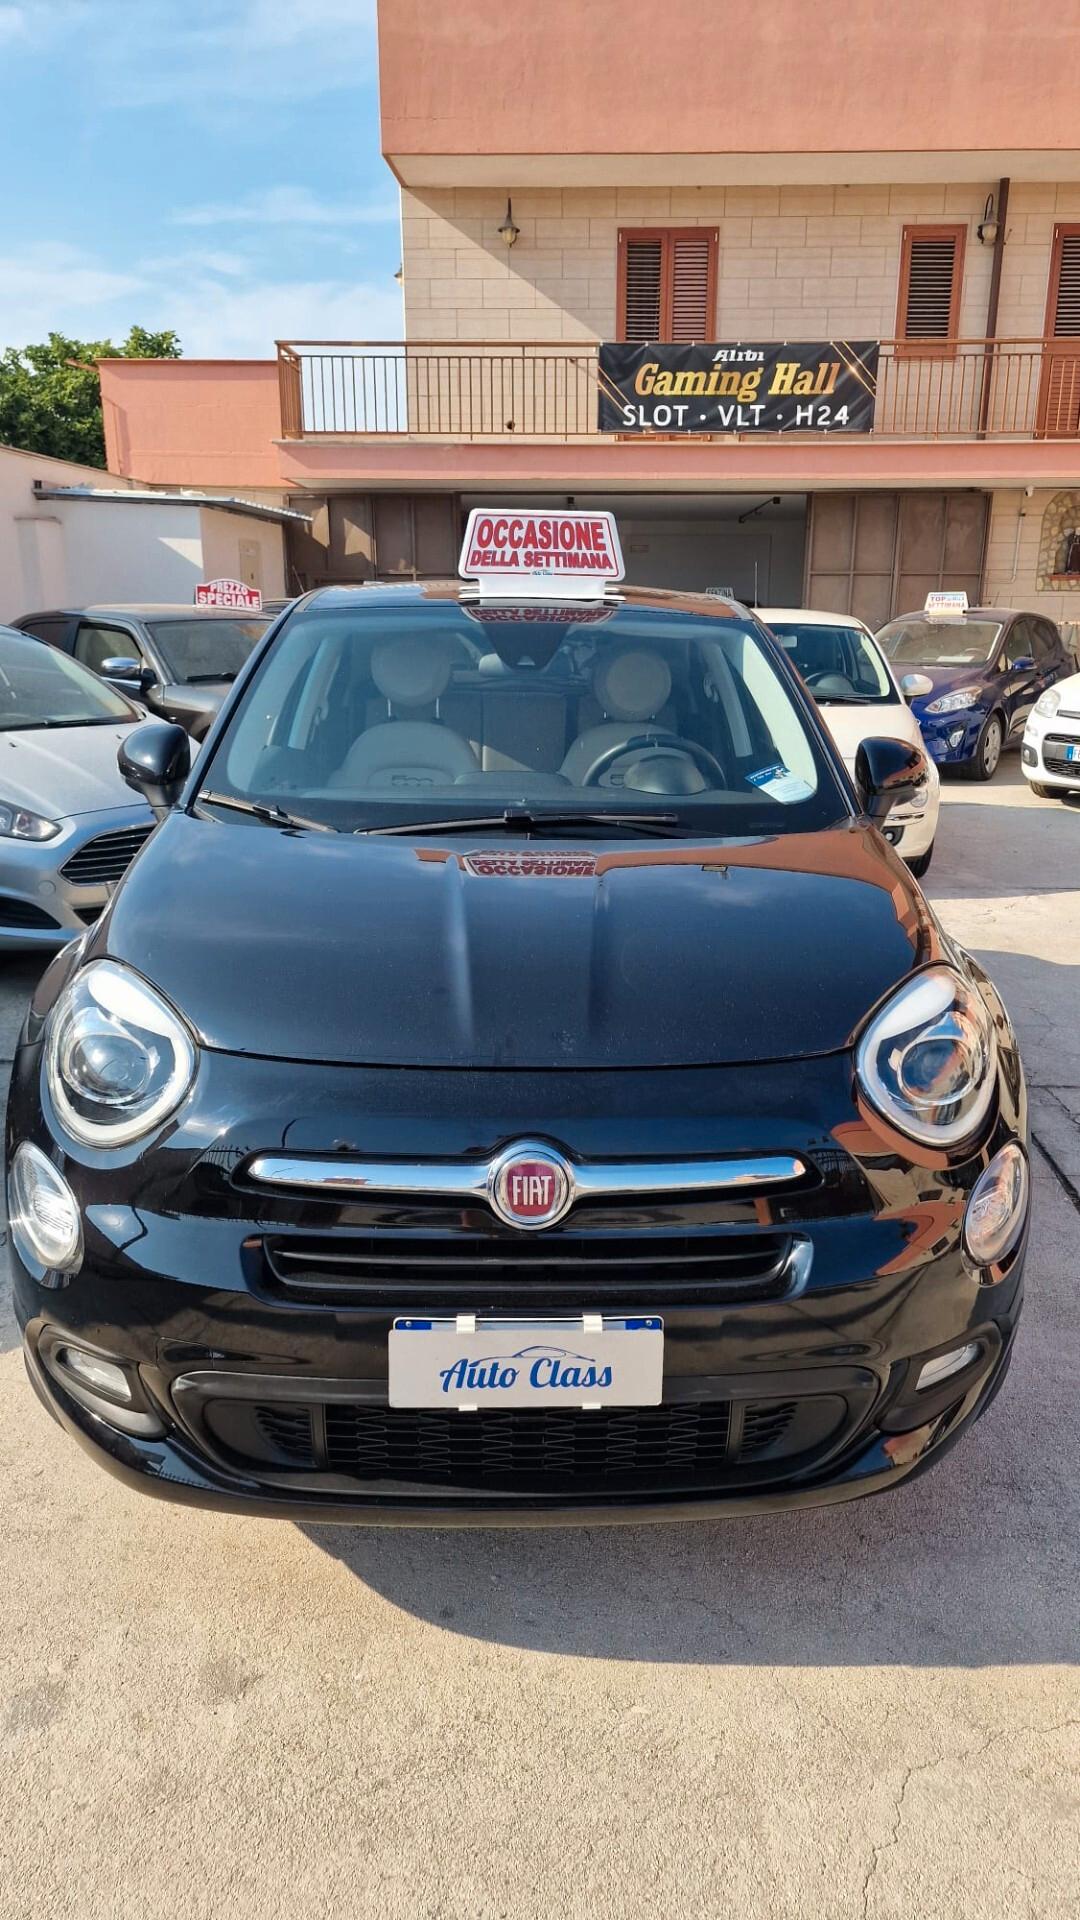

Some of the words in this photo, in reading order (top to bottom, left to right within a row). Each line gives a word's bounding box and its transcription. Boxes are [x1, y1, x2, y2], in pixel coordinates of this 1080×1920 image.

[634, 362, 763, 403] Gaming
[768, 362, 841, 395] Hall
[623, 404, 689, 427] SLOT
[718, 404, 766, 427] VLT
[796, 404, 850, 426] H24
[476, 518, 607, 551] OCCASIONE
[470, 550, 520, 567] DELLA
[524, 551, 613, 569] SETTIMANA
[198, 591, 260, 608] SPECIALE
[210, 581, 248, 596] PREZZO
[512, 1175, 552, 1206] FIAT
[439, 1357, 520, 1393] Auto
[529, 1357, 613, 1388] Class
